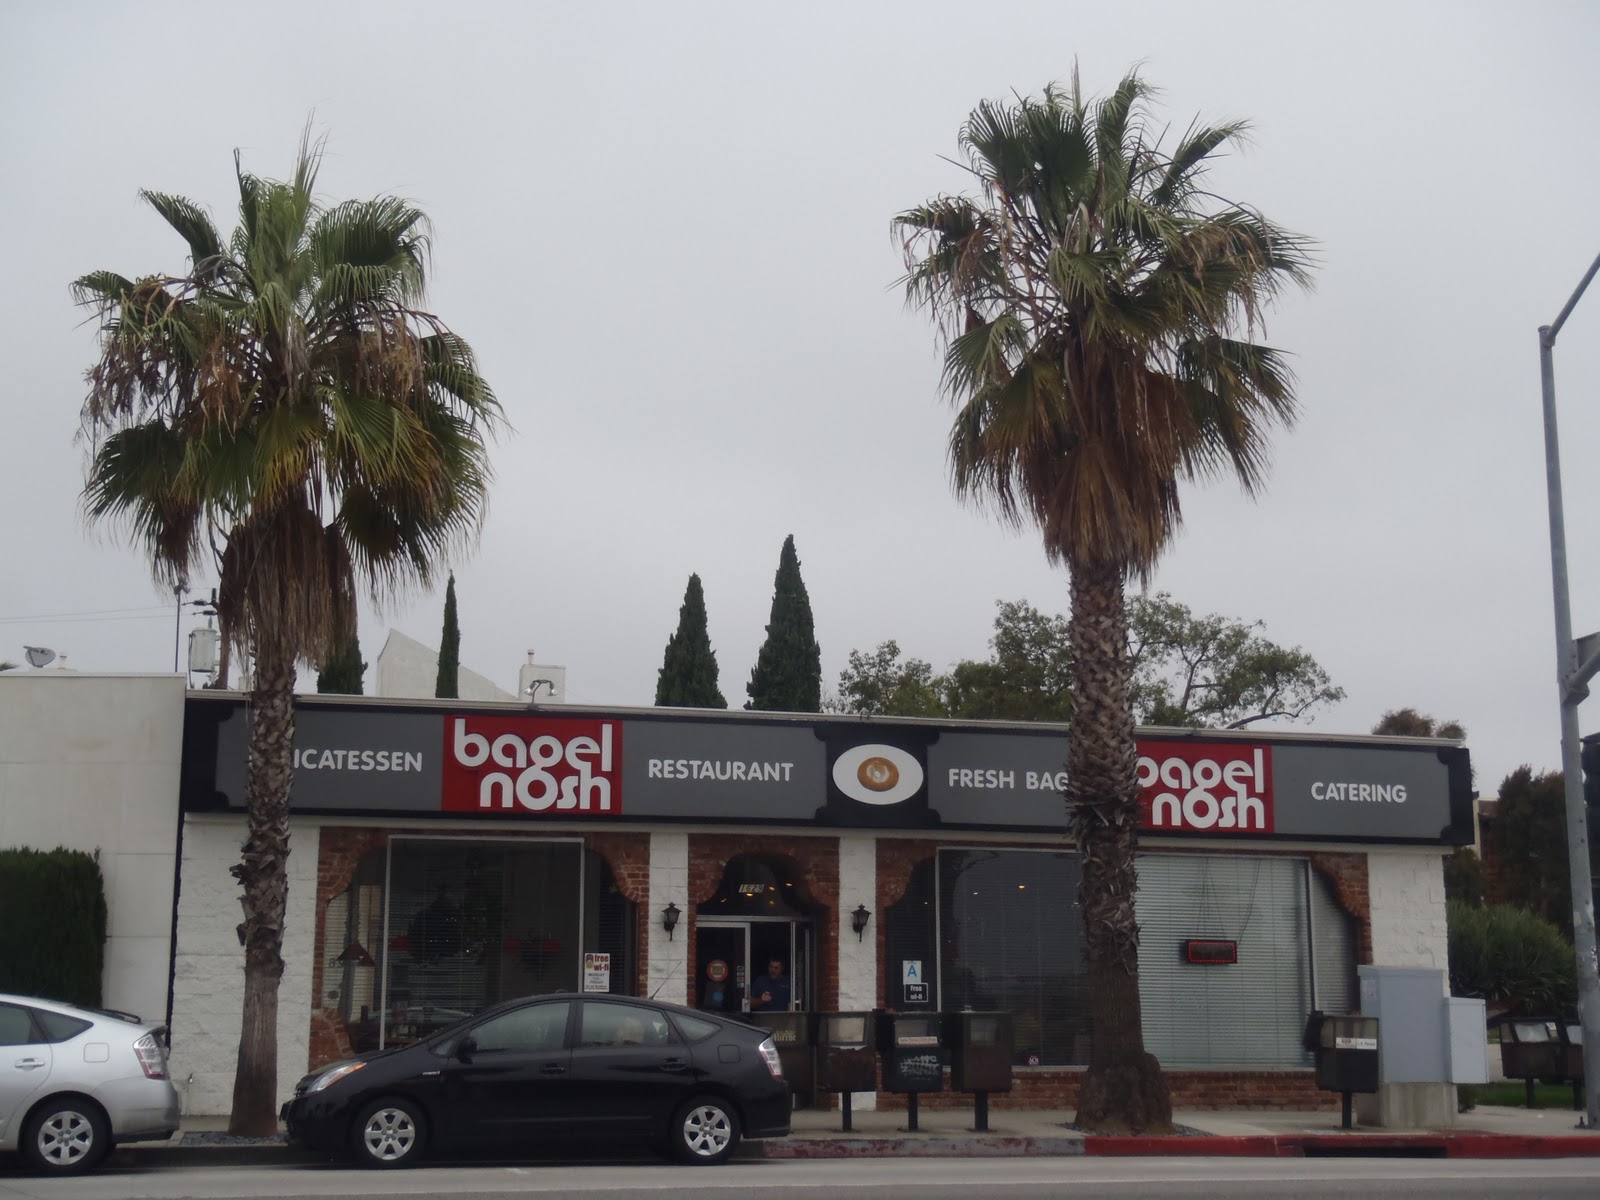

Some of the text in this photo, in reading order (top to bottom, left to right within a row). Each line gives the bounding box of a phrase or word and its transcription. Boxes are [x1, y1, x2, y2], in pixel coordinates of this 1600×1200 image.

[454, 717, 613, 774] bagel
[293, 748, 423, 773] ICATESSEN
[648, 758, 794, 782] RESTAURANT
[948, 767, 1015, 790] FRESH
[479, 769, 612, 812] nosh
[1310, 781, 1407, 804] CATERING
[1152, 789, 1266, 830] nosh
[740, 883, 764, 893] 1629
[594, 954, 609, 962] free
[907, 964, 917, 977] A
